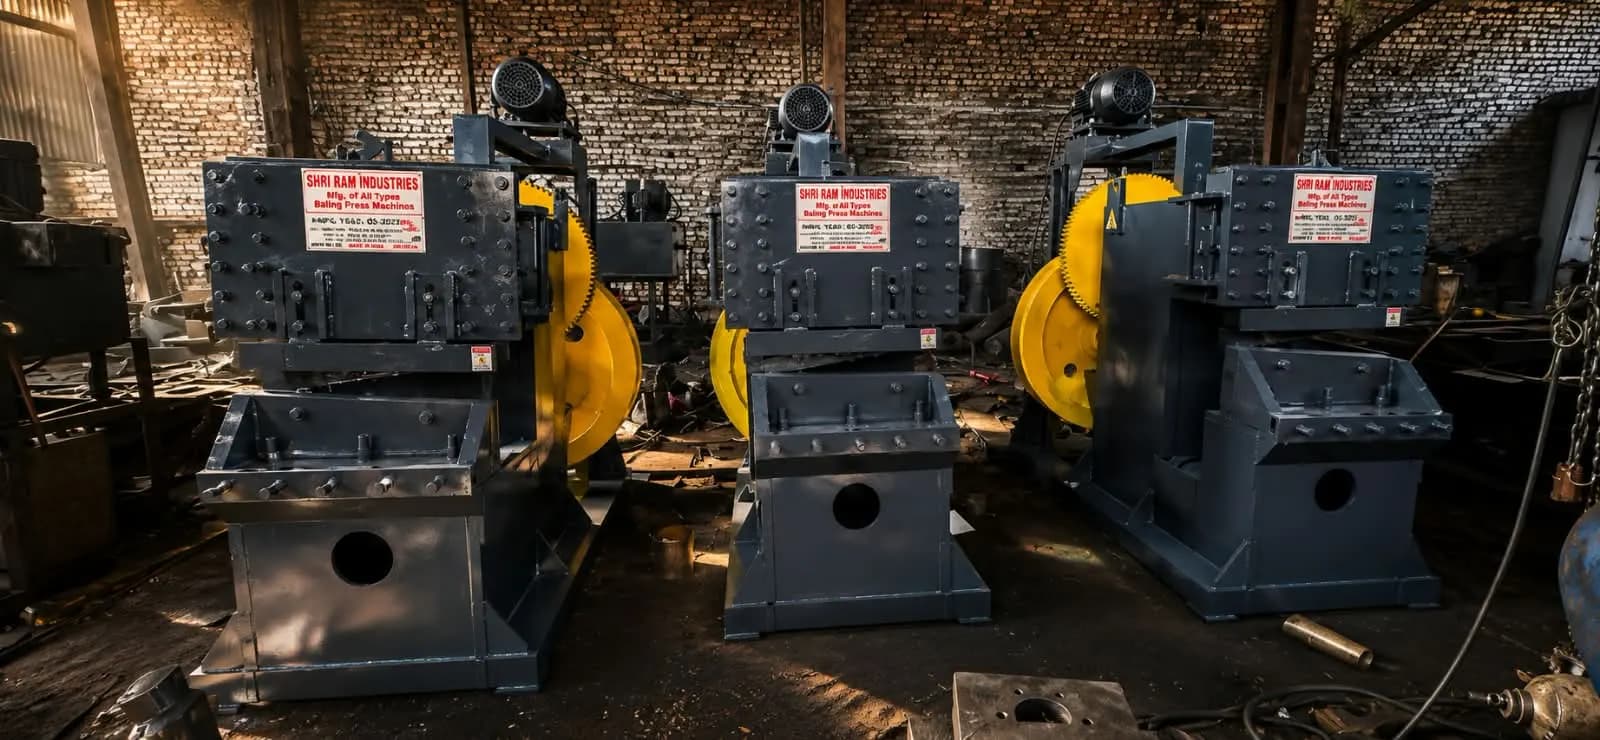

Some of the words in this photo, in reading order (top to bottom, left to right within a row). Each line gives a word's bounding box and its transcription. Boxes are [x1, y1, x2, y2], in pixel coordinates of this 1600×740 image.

[307, 175, 330, 188] SHRI
[334, 176, 356, 188] RAM
[360, 176, 418, 190] INDUSTRIES
[1297, 179, 1313, 189] SHRI
[1315, 180, 1330, 190] RAM
[1333, 180, 1372, 191] INDUSTRIES
[327, 192, 346, 200] Mfg.
[375, 193, 400, 201] Types
[800, 188, 818, 199] SHRI
[821, 188, 838, 199] RAM
[841, 188, 886, 199] INDUSTRIES
[314, 200, 342, 209] Baling
[372, 202, 414, 210] Machines
